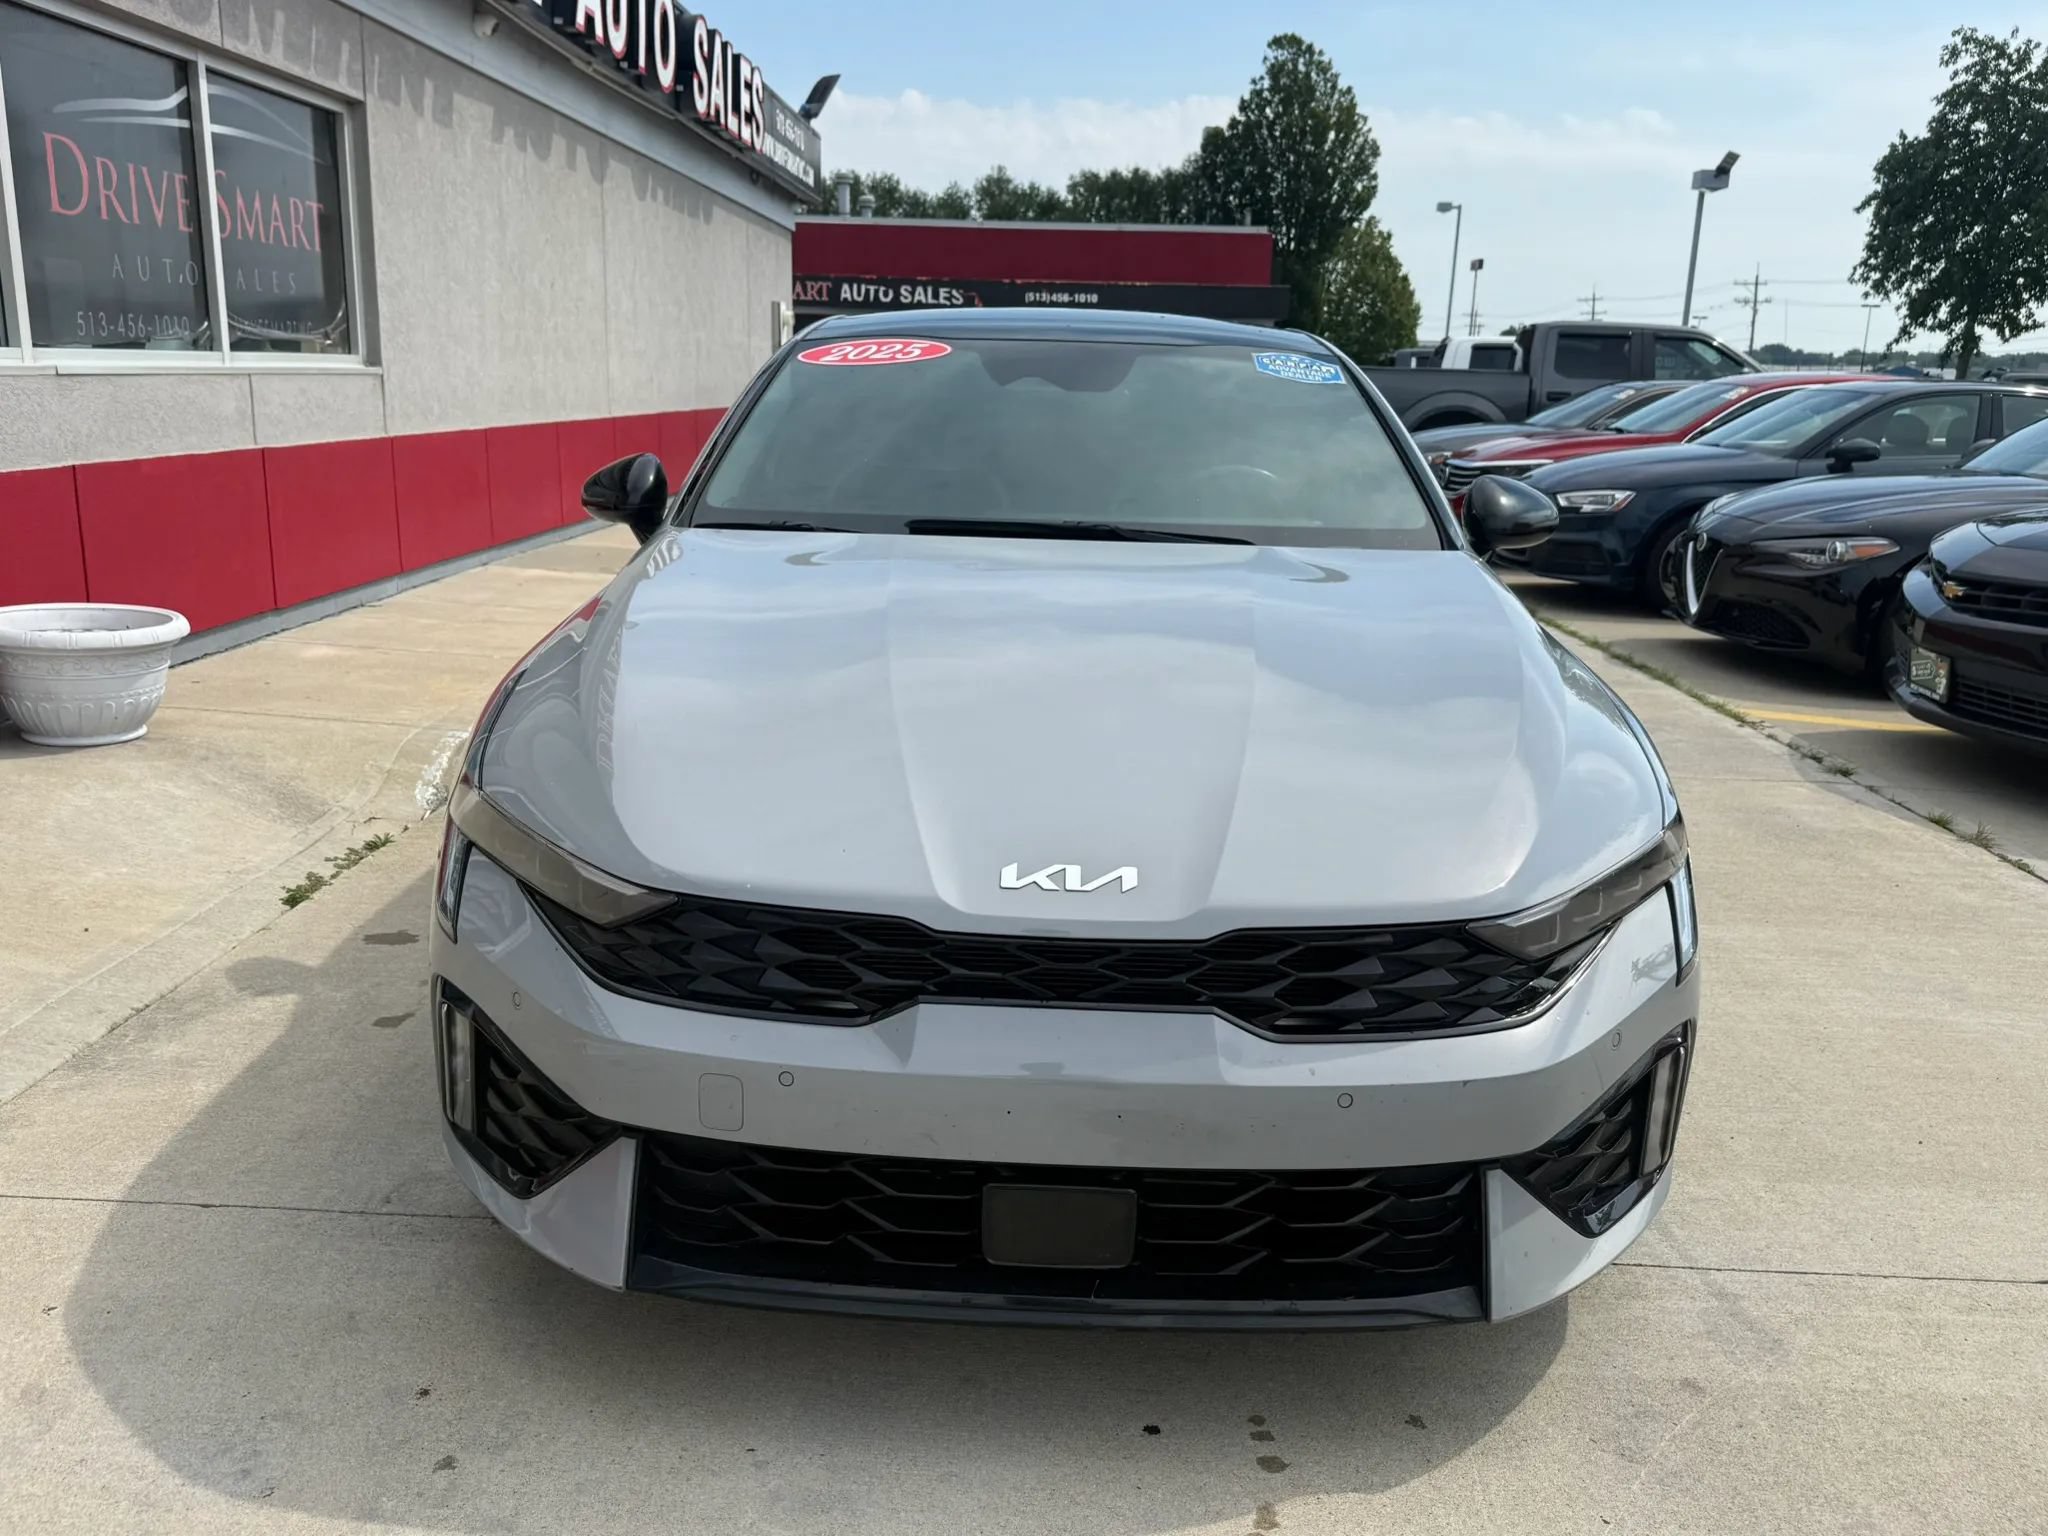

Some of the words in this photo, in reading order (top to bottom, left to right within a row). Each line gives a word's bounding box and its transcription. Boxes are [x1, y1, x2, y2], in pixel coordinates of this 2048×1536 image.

[693, 15, 765, 154] SALES
[43, 131, 193, 232] DRIVE
[215, 169, 325, 252] SMART
[112, 254, 199, 285] AUTO
[236, 269, 296, 294] ALES
[840, 283, 894, 303] AUTO
[900, 285, 964, 305] SALES
[819, 343, 930, 361] 2025
[1000, 862, 1138, 893] KIA
